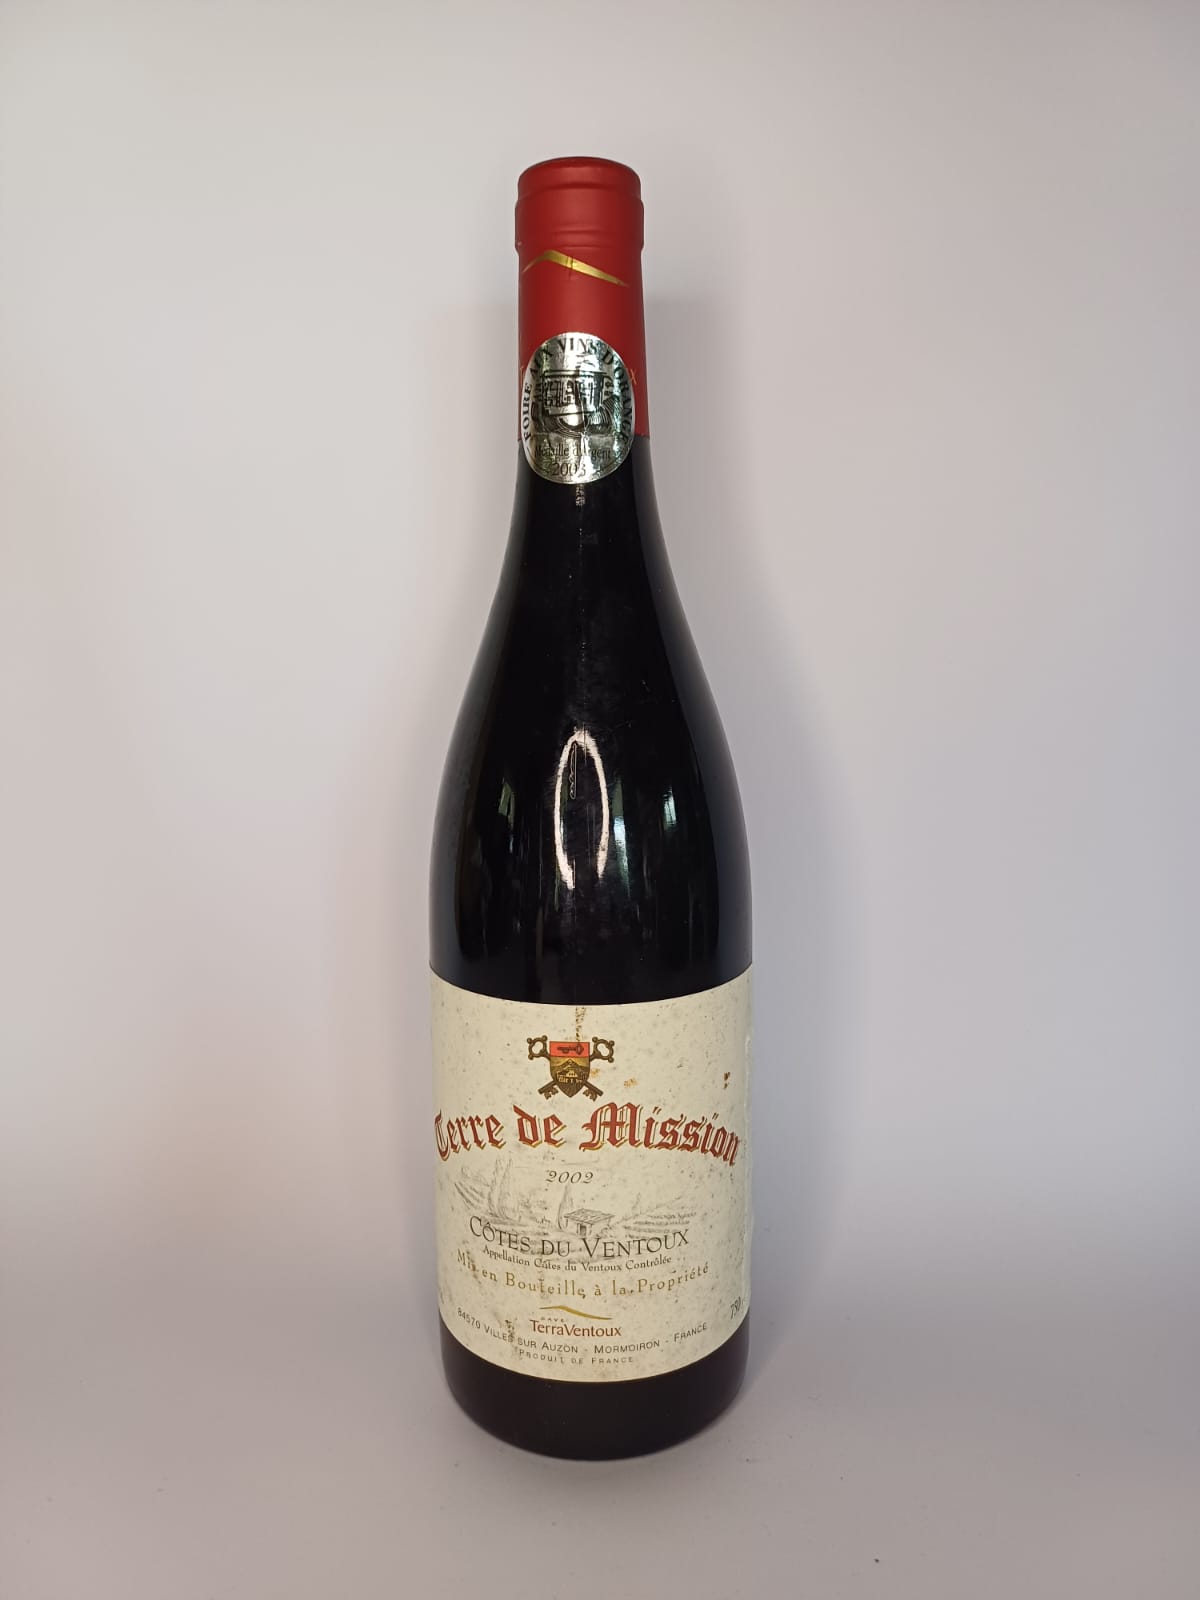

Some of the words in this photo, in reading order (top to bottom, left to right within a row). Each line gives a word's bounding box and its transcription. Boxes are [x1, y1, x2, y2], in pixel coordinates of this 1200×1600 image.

[557, 337, 600, 352] VINS
[551, 462, 587, 477] 2003
[434, 1108, 506, 1162] Terre
[512, 1103, 567, 1150] de
[578, 1102, 740, 1167] Mission
[545, 1169, 594, 1184] 2002
[469, 1215, 531, 1253] CÔTES
[541, 1239, 571, 1258] DU
[581, 1228, 690, 1259] VENTOUX
[482, 1244, 531, 1267] Appellation
[564, 1259, 577, 1272] du
[581, 1262, 622, 1273] Ventoux
[625, 1253, 672, 1271] Contrôlée
[482, 1268, 498, 1283] en
[505, 1271, 586, 1296] Bouteille
[594, 1284, 602, 1296] à
[612, 1279, 630, 1296] la
[637, 1261, 709, 1293] Propriété
[517, 1337, 537, 1349] SUR
[541, 1341, 578, 1354] AUZON
[594, 1339, 660, 1354] MORMOIRON
[673, 1322, 708, 1343] FRANCE
[530, 1319, 622, 1338] TerraVentoux
[591, 1356, 633, 1365] FRANCE
